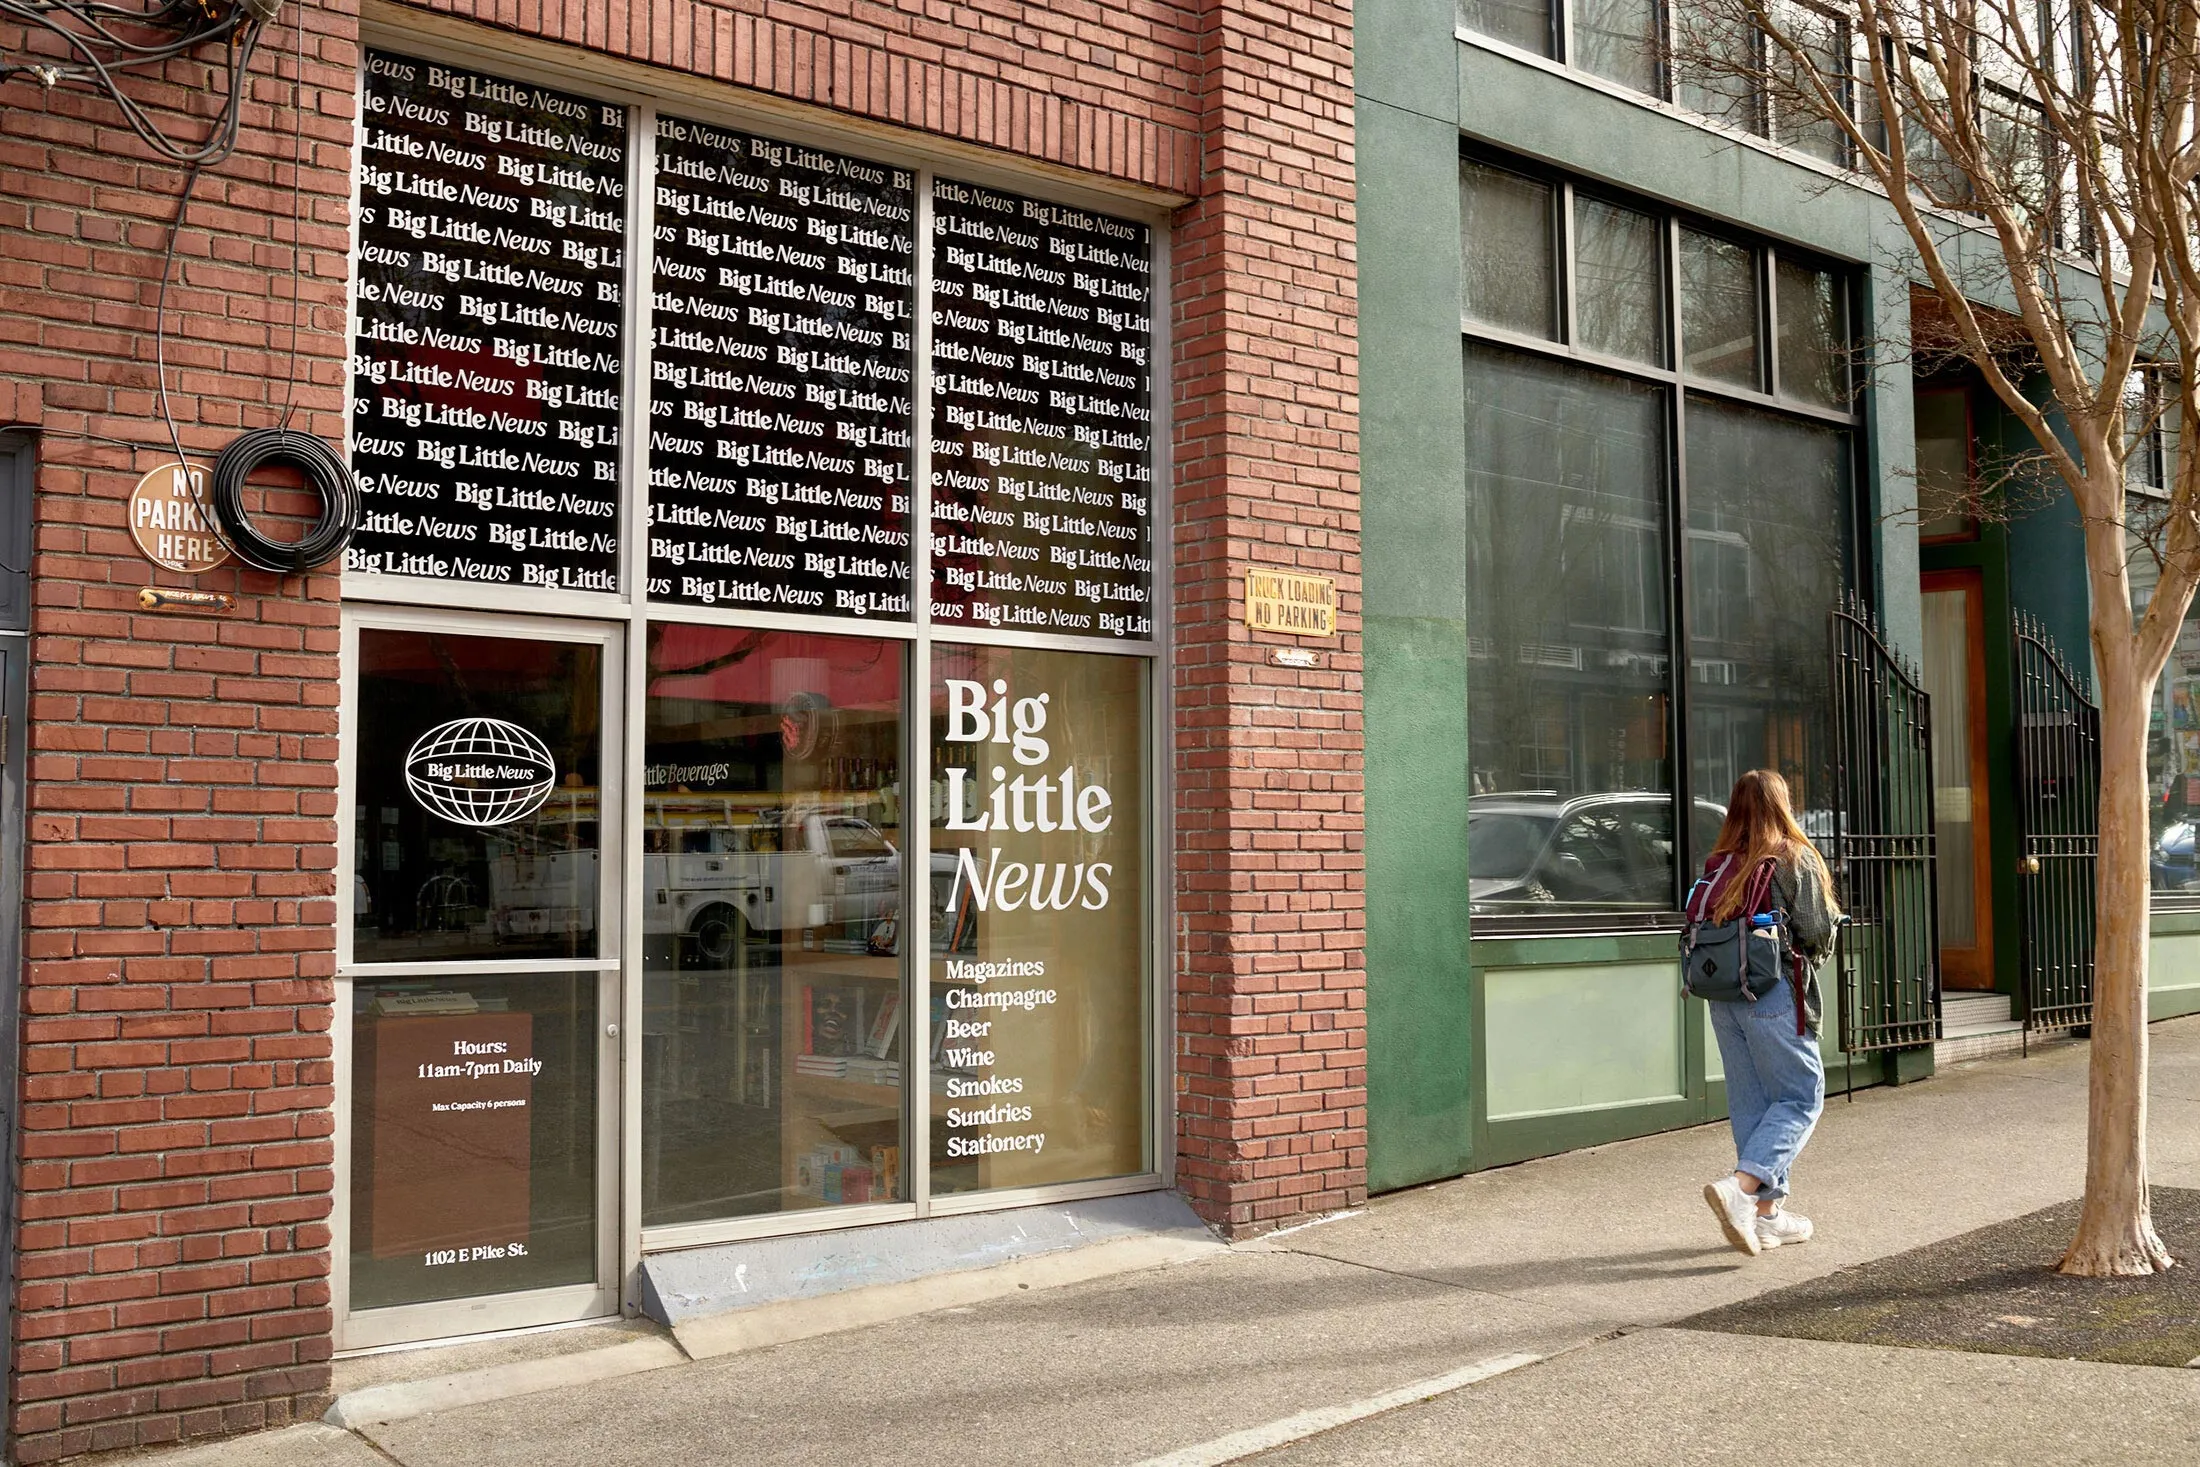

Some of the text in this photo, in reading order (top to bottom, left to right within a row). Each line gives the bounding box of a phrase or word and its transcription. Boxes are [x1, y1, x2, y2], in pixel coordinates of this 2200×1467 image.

[427, 66, 587, 120] Big Little News
[464, 111, 621, 162] Big Little News
[424, 140, 595, 193] News Big Little
[750, 138, 884, 184] Big Little News
[655, 186, 798, 232] Big Little News
[778, 177, 911, 222] Big Little News
[386, 206, 552, 255] Big Little News
[1022, 200, 1134, 240] Big Little News
[686, 226, 826, 270] Big Little News
[994, 225, 1119, 267] News Big Little
[421, 250, 584, 297] Big Little News
[946, 245, 1066, 286] Big Little News
[718, 266, 856, 309] Big Little News
[971, 282, 1090, 321] Big Little News
[458, 294, 618, 338] Big Little News
[747, 306, 883, 346] Big Little News
[419, 325, 591, 370] News Big Little
[997, 318, 1113, 355] Big Little News
[652, 360, 796, 399] Big Little News
[776, 344, 910, 383] Big Little News
[1022, 353, 1136, 389] Big Little News
[994, 380, 1120, 417] News Big Little
[381, 396, 548, 437] Big Little News
[683, 399, 825, 437] Big Little News
[945, 404, 1066, 439] Big Little News
[416, 439, 580, 477] Big Little News
[716, 439, 855, 474] Big Little News
[971, 440, 1090, 474] Big Little News
[173, 468, 203, 498] NO
[454, 481, 614, 517] Big Little News
[745, 477, 883, 511] Big Little News
[997, 475, 1114, 507] Big Little News
[137, 498, 222, 533] PARKIN
[774, 515, 908, 546] Big Little News
[1022, 510, 1137, 540] Big Little News
[158, 534, 214, 562] HERE
[650, 537, 795, 569] Big Little News
[994, 539, 1121, 570] News Big Little
[681, 576, 824, 606] Big Little News
[945, 566, 1067, 595] Big Little News
[1248, 575, 1332, 605] TRUCK LOADING
[971, 601, 1091, 628] Big Little News
[1255, 602, 1326, 630] NO PARKING
[944, 678, 1050, 766] Big
[427, 763, 535, 781] Big Little News
[644, 763, 729, 786] ittle Beverages
[944, 765, 1112, 833] Little
[945, 847, 1113, 912] News
[946, 957, 1045, 984] Magazines
[945, 988, 1057, 1012] Champagne
[946, 1019, 992, 1039] Beer
[454, 1040, 507, 1055] Hours:
[945, 1047, 995, 1068] Wine
[418, 1057, 542, 1080] 11am-7pm Daily
[946, 1074, 1023, 1098] Smokes
[432, 1099, 526, 1112] Max Capacity 6 persons
[946, 1102, 1032, 1128] Sundries
[947, 1133, 1045, 1157] Stationery
[425, 1242, 528, 1266] 1102 E Pike St.
